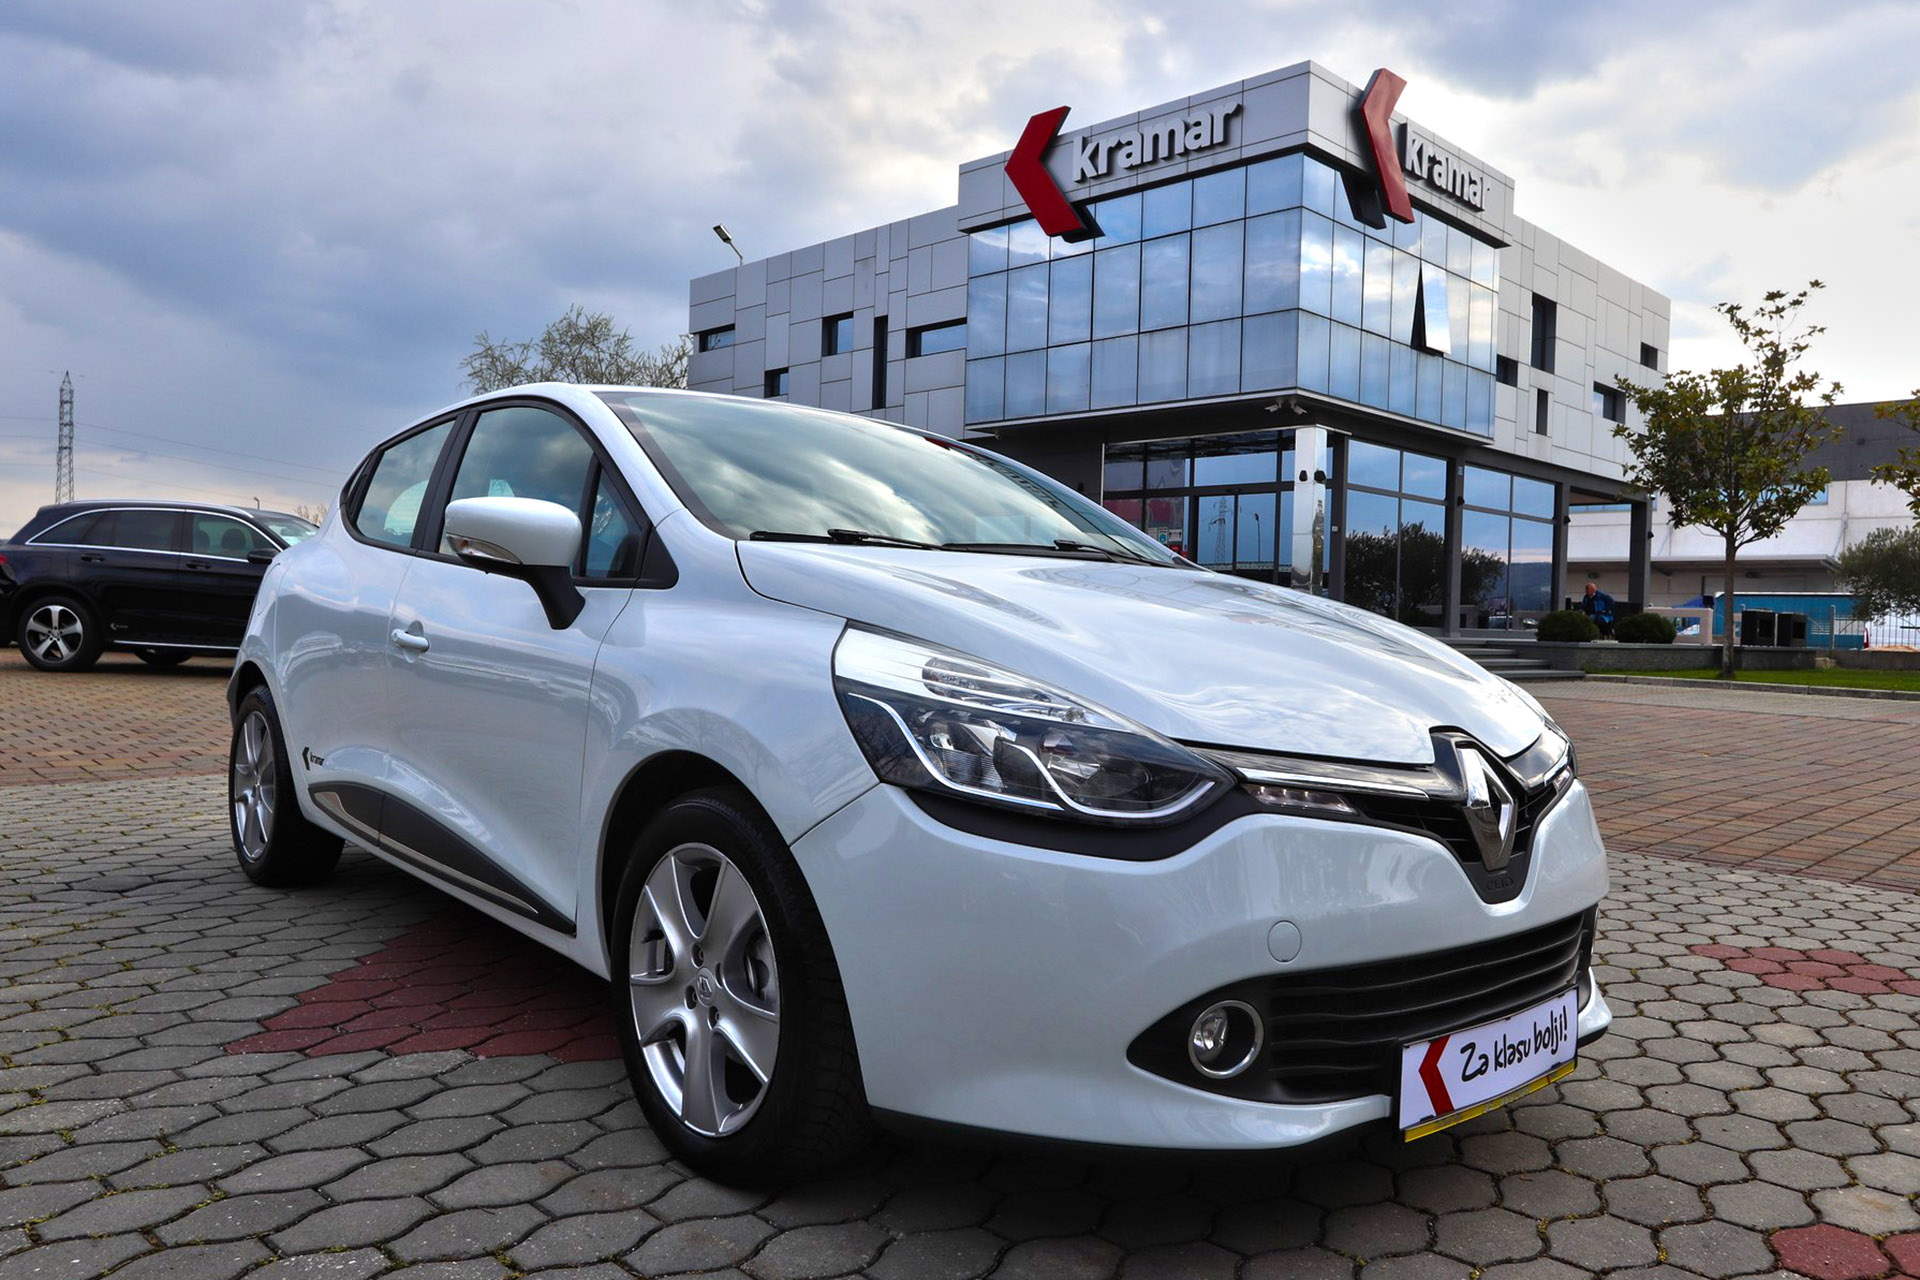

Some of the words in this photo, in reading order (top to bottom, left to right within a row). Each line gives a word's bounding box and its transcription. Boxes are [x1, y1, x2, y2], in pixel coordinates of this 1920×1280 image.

[1072, 101, 1239, 183] kramar
[1404, 122, 1490, 211] kramar
[1460, 1041, 1489, 1082] Za
[1494, 1033, 1531, 1072] klasu
[1533, 1005, 1568, 1056] bolji!
